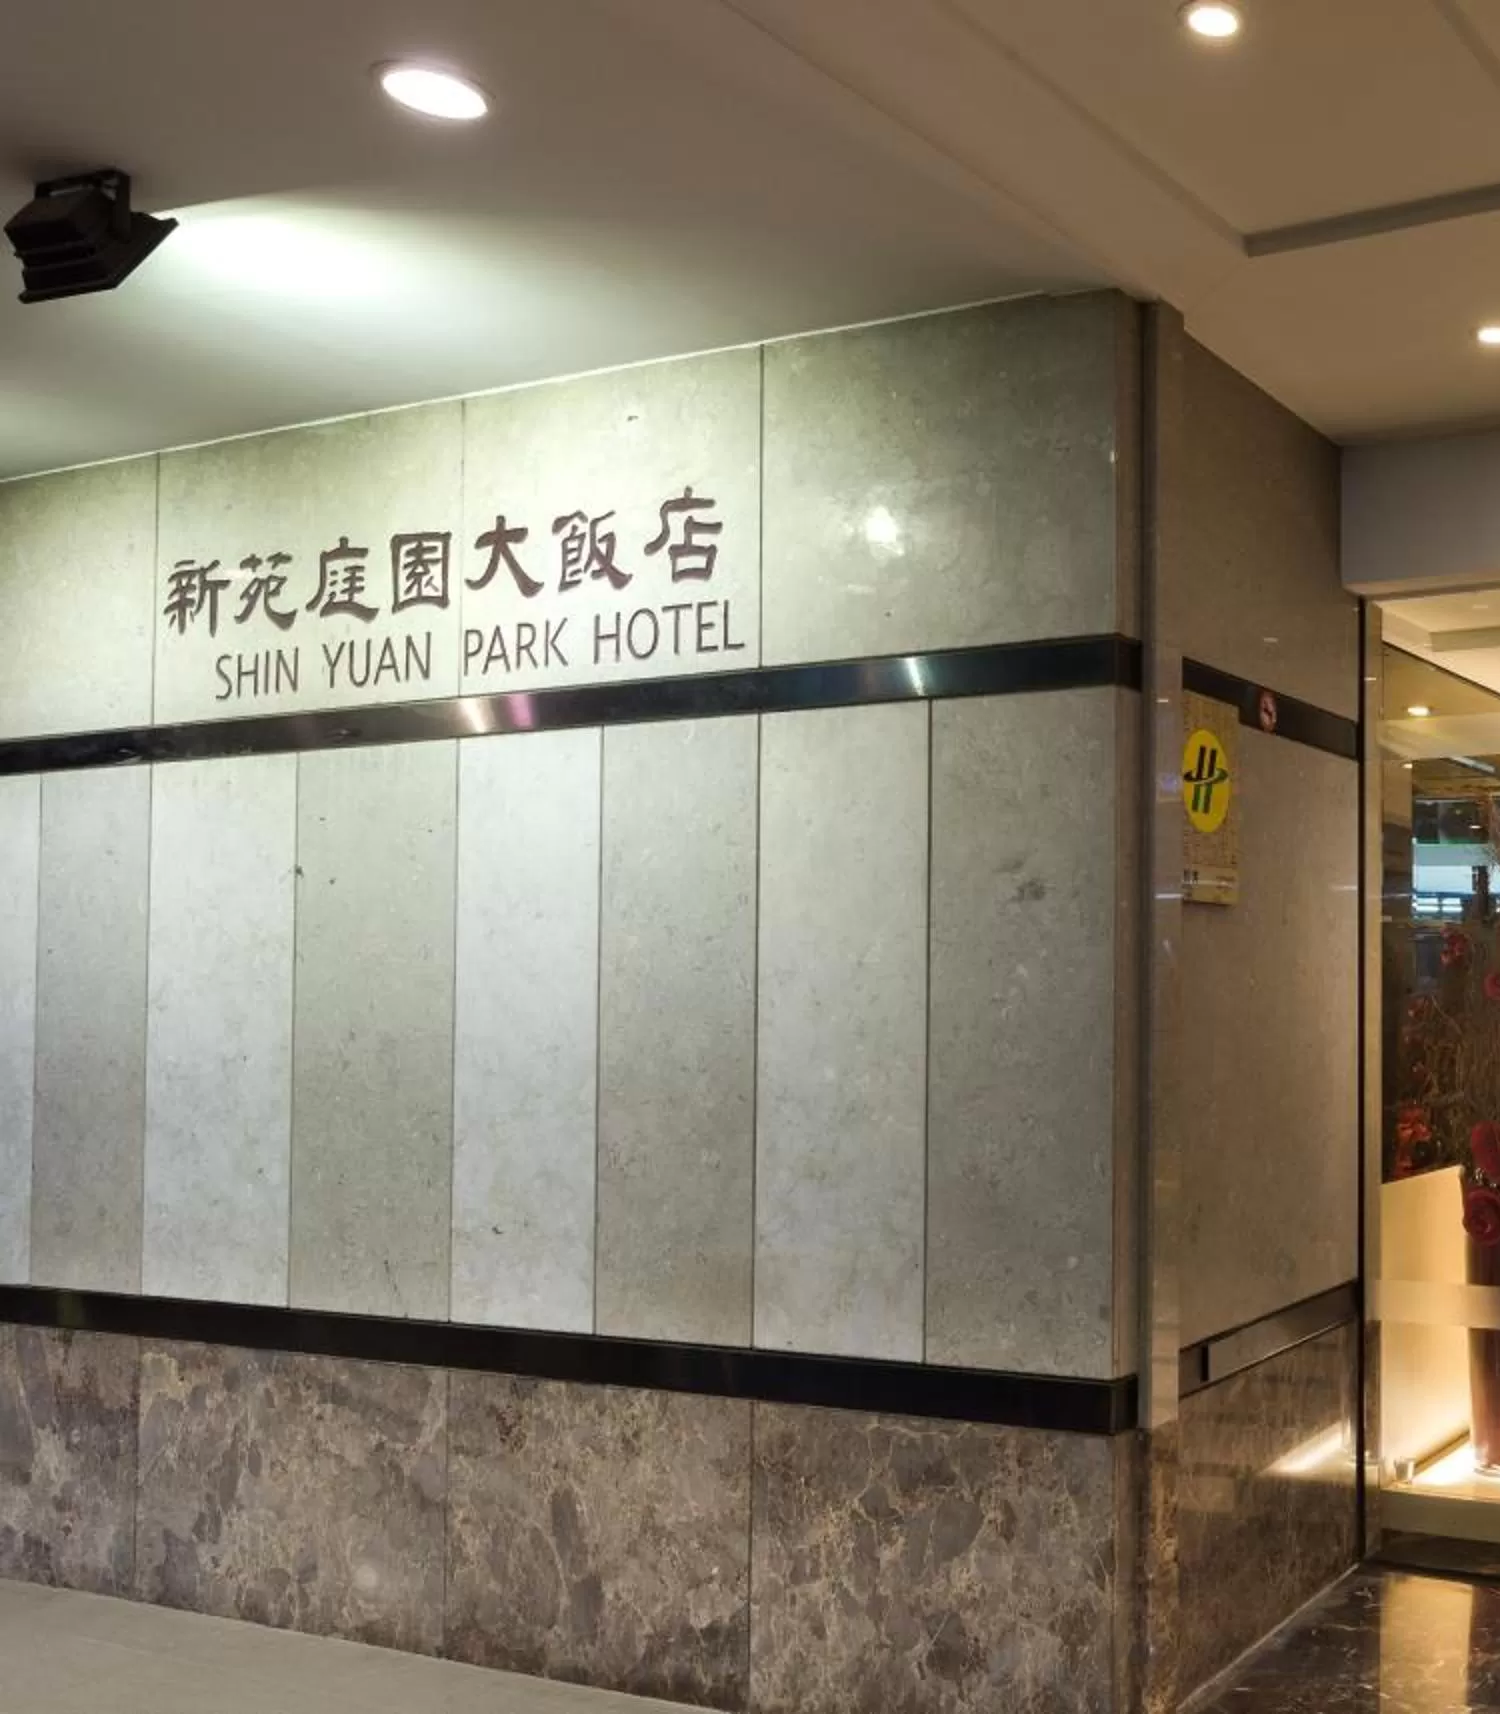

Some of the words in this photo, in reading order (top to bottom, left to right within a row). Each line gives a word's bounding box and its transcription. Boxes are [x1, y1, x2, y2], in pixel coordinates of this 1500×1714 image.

[163, 486, 723, 637] 新苑庭園大飯店
[215, 648, 299, 701] SHIN
[321, 632, 431, 689] YUAN
[463, 617, 569, 676] PARK
[593, 601, 746, 664] HOTEL
